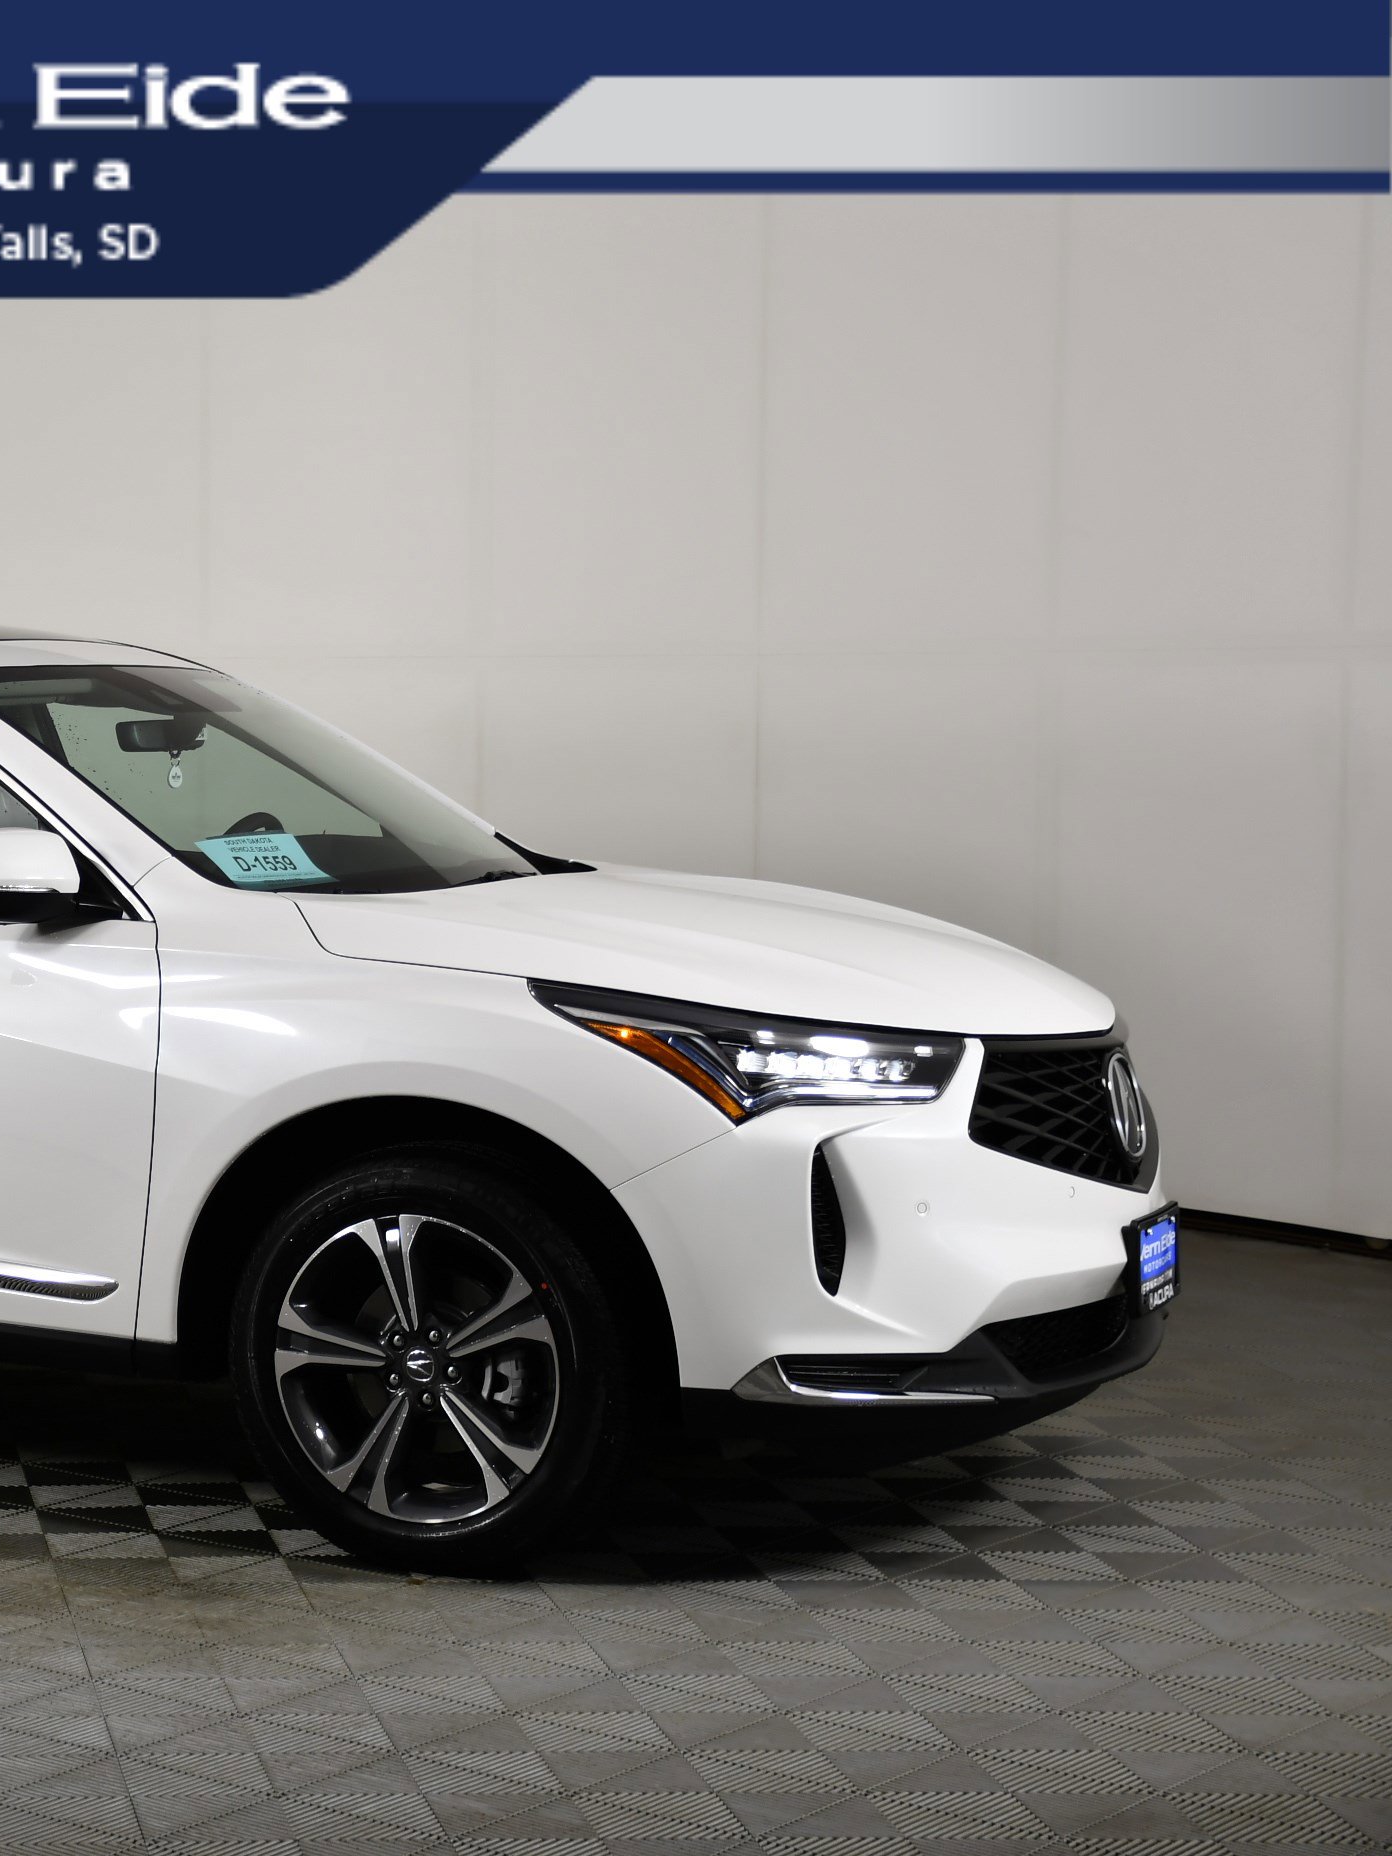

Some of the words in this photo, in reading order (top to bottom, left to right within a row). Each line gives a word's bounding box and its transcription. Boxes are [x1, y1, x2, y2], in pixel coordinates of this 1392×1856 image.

[224, 838, 247, 846] SOUTH
[248, 837, 274, 845] DAKOTA
[232, 855, 298, 872] D-1559
[1154, 1283, 1174, 1307] ACURA
